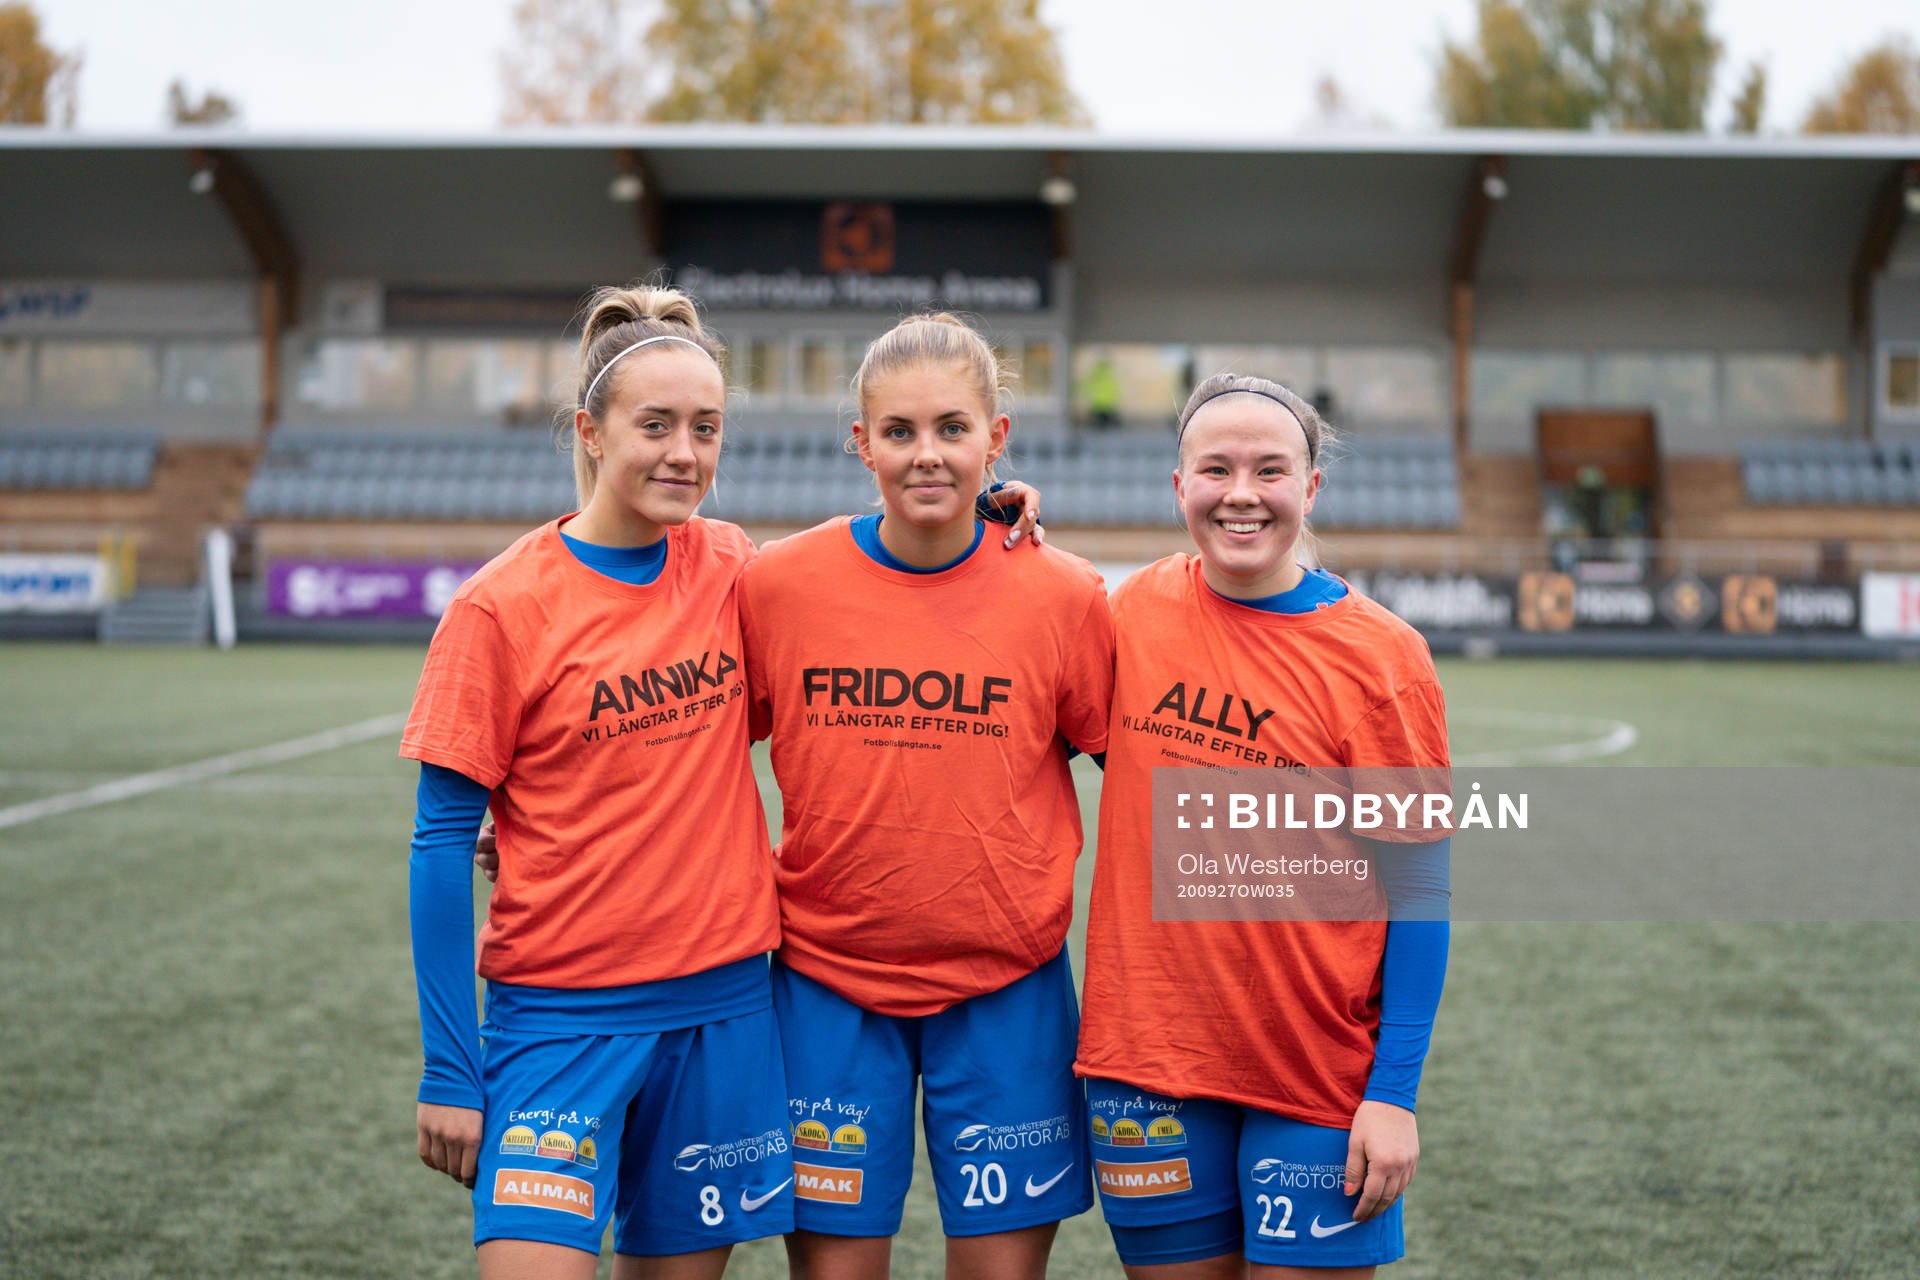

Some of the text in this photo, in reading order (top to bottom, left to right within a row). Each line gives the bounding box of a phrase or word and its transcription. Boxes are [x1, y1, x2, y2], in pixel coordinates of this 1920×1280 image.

[589, 649, 737, 721] ANNIKA
[803, 667, 1012, 715] FRIDOLF
[582, 729, 600, 742] VI
[606, 709, 678, 738] LÄNGTAR
[684, 693, 726, 719] EFTER
[806, 710, 1009, 738] VI LÄNGTAR EFTER DIG!
[1152, 681, 1276, 742] ALLY
[1122, 715, 1312, 778] VI LÄNGTAR EFTER DIG!
[509, 1107, 556, 1126] Energi
[558, 1110, 581, 1129] på
[811, 1097, 834, 1118] på
[838, 1103, 871, 1124] väg!
[1124, 1095, 1145, 1117] på
[987, 1127, 1052, 1151] MOTOR
[1055, 1122, 1070, 1143] AB
[988, 1125, 1016, 1136] NORRA
[708, 1143, 736, 1154] NORRA
[709, 1143, 766, 1171] MOTOR
[766, 1137, 788, 1158] AB
[1101, 1170, 1180, 1187] ALIMAK
[1280, 1163, 1308, 1172] NORRA
[503, 1180, 590, 1207] ALIMAK
[794, 1173, 854, 1193] MAK
[959, 1162, 1008, 1207] 20
[700, 1184, 725, 1226] 8
[1255, 1193, 1297, 1239] 22
